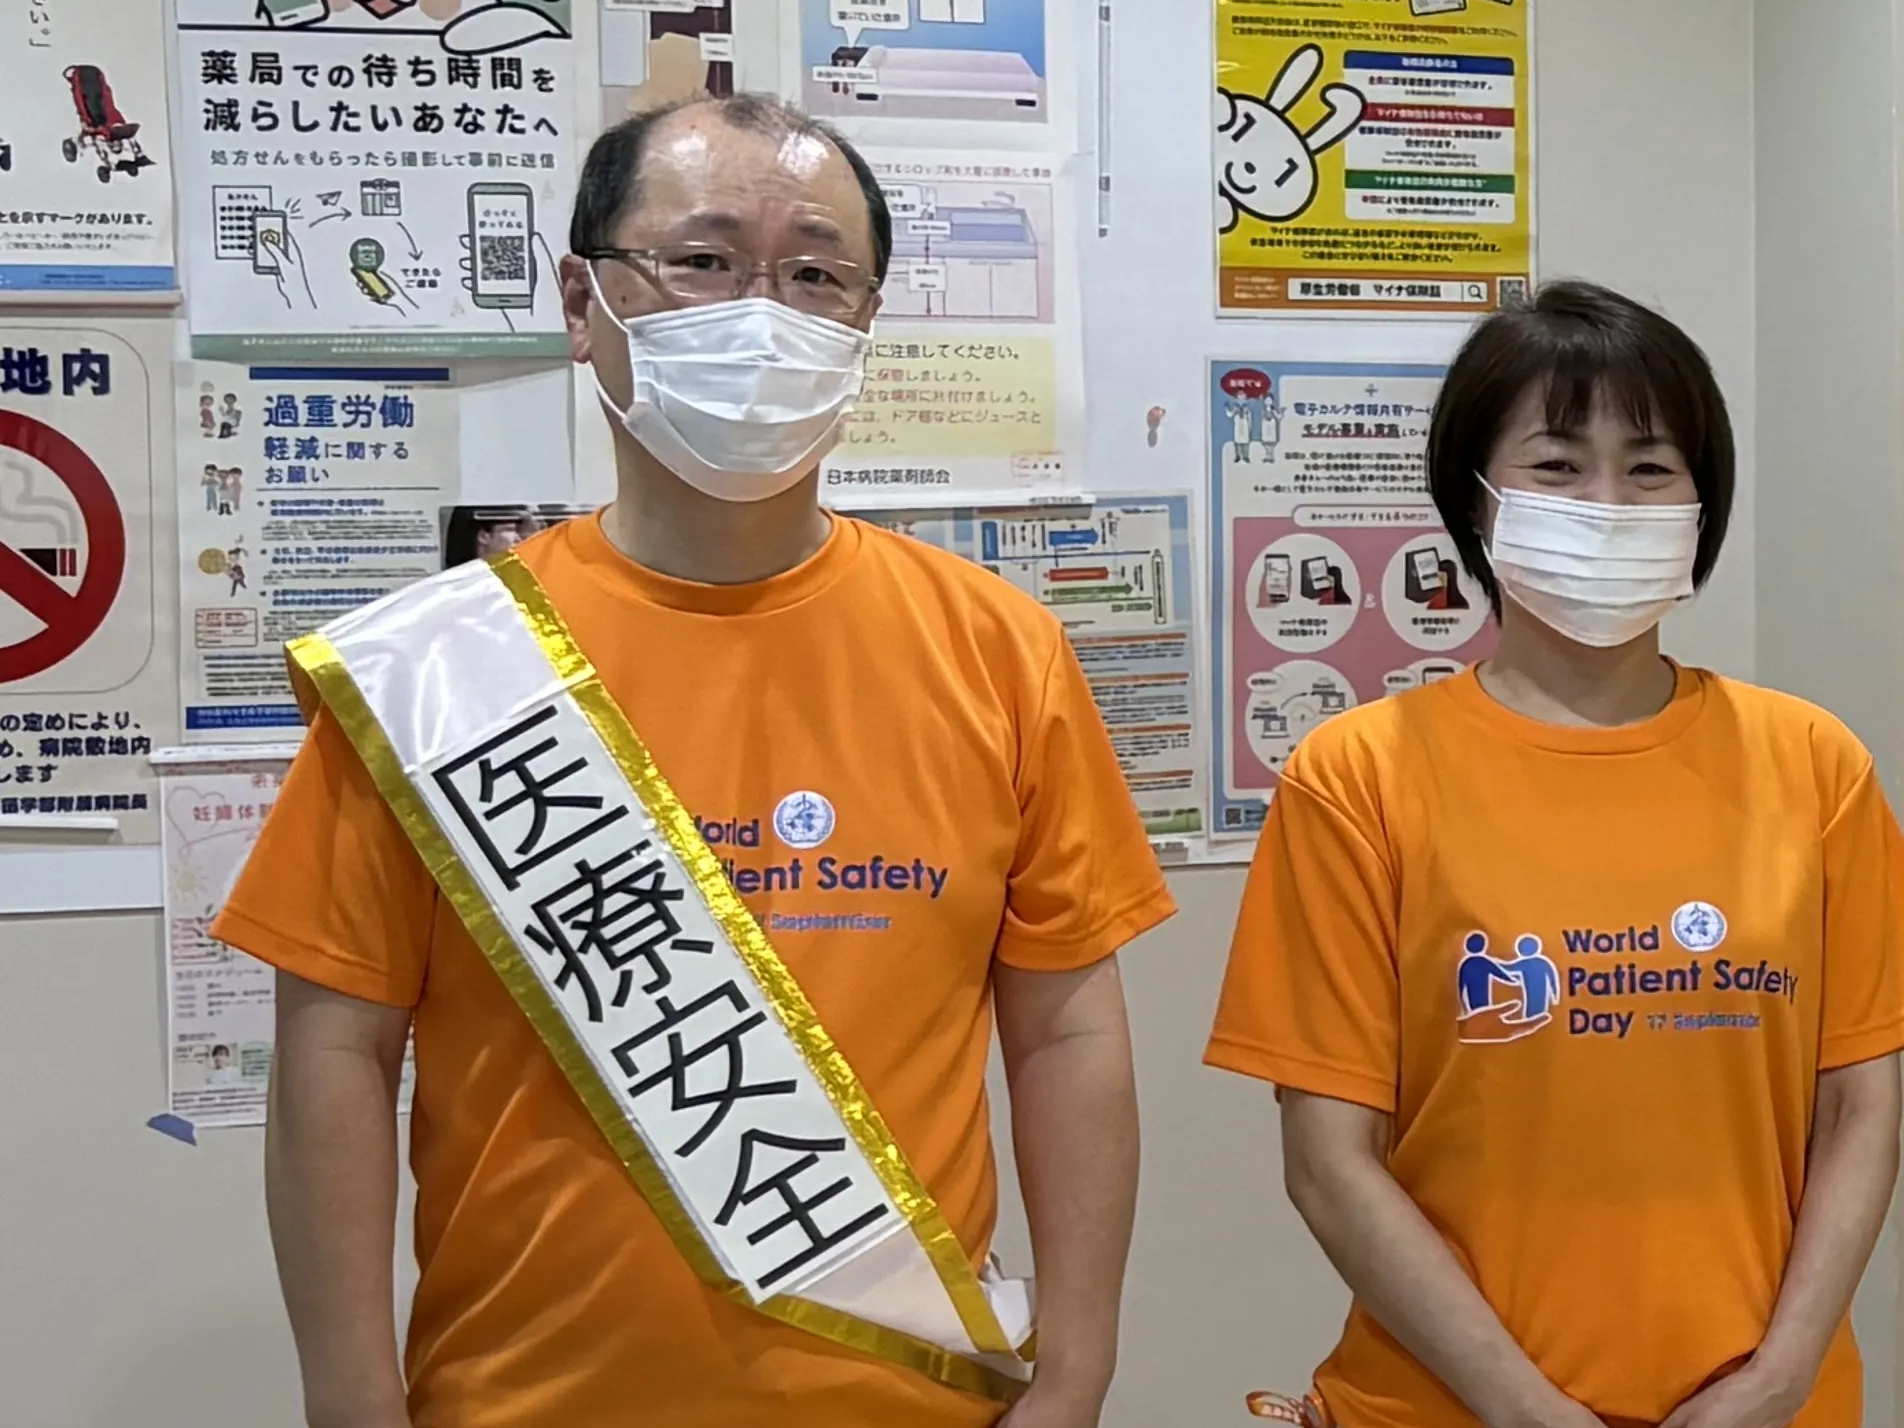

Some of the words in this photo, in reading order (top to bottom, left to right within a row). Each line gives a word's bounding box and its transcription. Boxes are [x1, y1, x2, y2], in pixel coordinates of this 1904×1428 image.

[200, 51, 556, 93] 薬局での待ち時間を
[203, 99, 559, 137] 減らしたいあなたへ
[0, 347, 110, 397] 地内
[263, 394, 414, 428] 過重労働
[855, 389, 1037, 404] 全な場所に片付けましょう。
[264, 436, 409, 461] 軽減に関する
[265, 465, 329, 484] お願い
[827, 468, 951, 486] 日本病院薬剤師会
[0, 711, 141, 732] の定めにより、
[722, 858, 803, 894] ient
[817, 855, 949, 899] Safety
[1562, 924, 1661, 954] World
[431, 703, 900, 1290] 医療安全
[1568, 963, 1703, 998] Patient
[1568, 1008, 1635, 1039] Day
